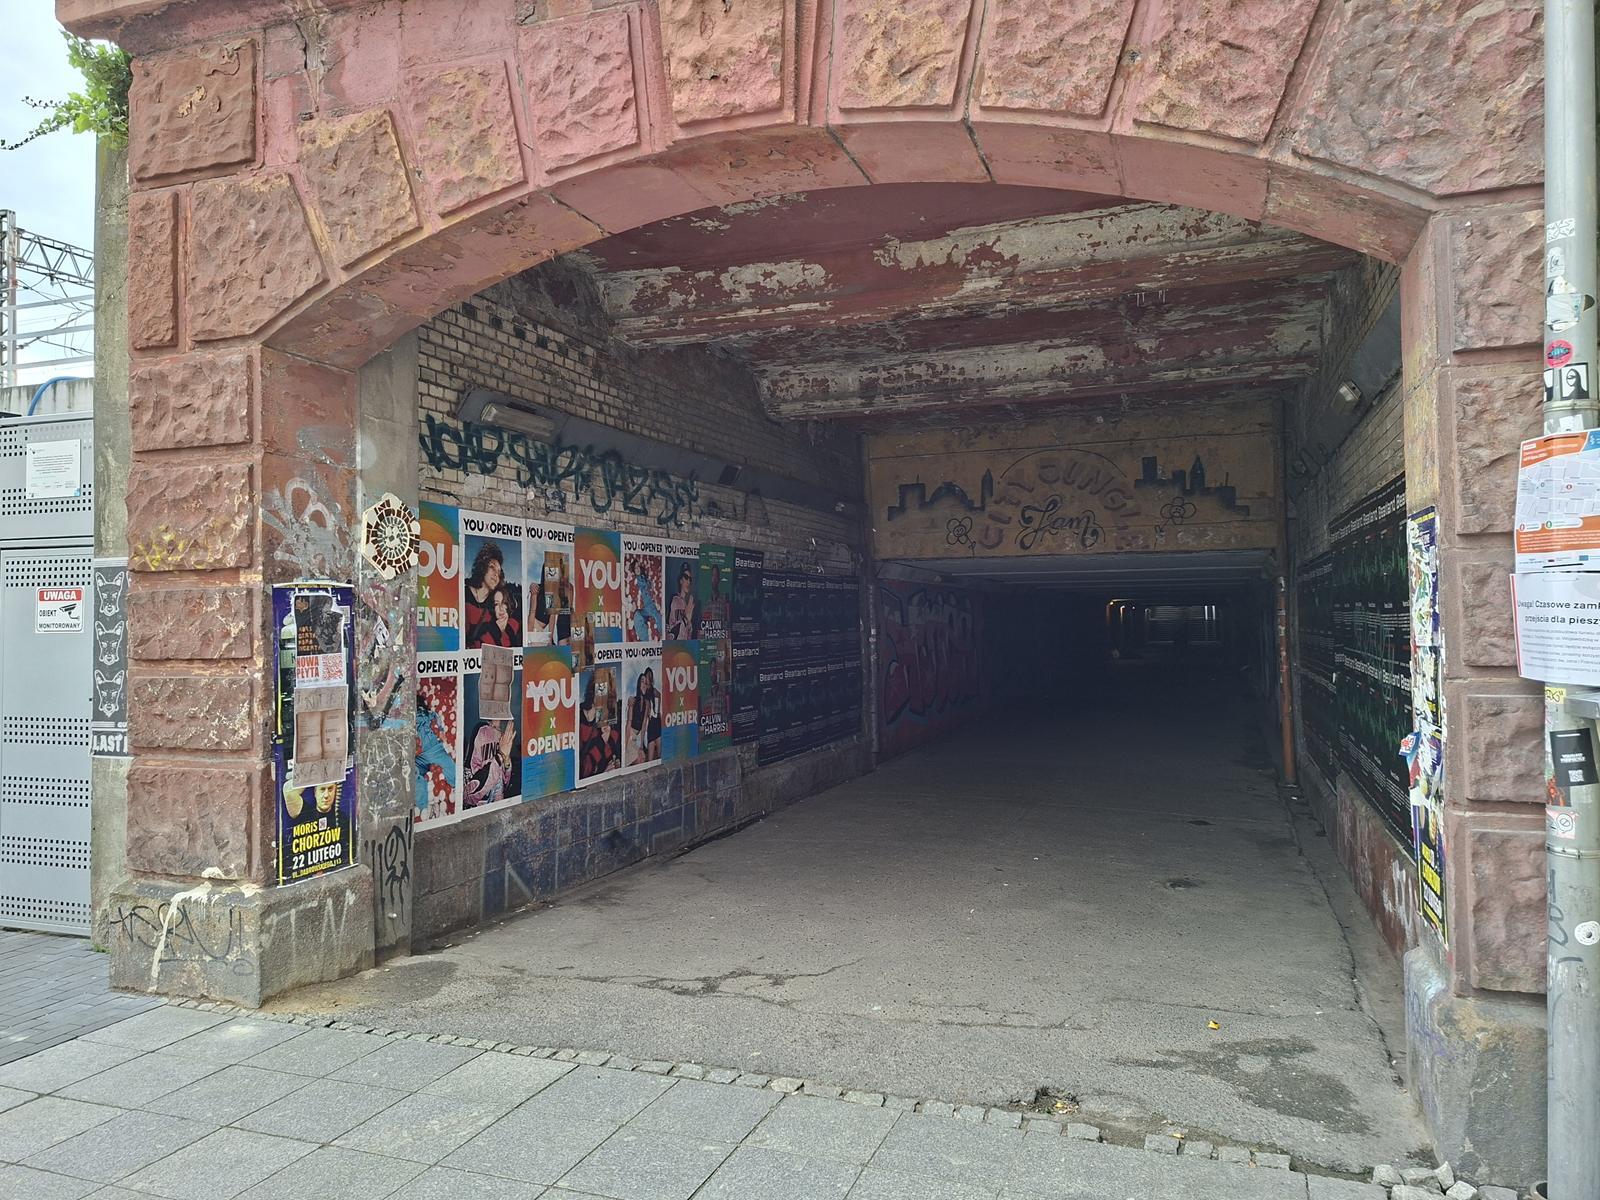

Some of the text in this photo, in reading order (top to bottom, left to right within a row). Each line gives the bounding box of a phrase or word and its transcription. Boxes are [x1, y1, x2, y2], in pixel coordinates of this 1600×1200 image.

[463, 518, 484, 533] YOU
[526, 526, 543, 540] YOU
[623, 540, 638, 551] YOU
[664, 544, 677, 555] YOU
[419, 540, 459, 579] OU
[579, 559, 621, 590] YOU
[44, 590, 77, 600] UWAGA
[1535, 600, 1570, 609] Czasowe
[39, 609, 57, 617] OBIEKT
[700, 620, 721, 630] CALVIN
[1569, 616, 1600, 625] piesz
[625, 648, 638, 658] YOU
[463, 657, 481, 671] YOU
[665, 666, 698, 692] YOU
[526, 676, 578, 712] YOU
[700, 714, 721, 726] CALVIN
[292, 827, 341, 853] CHORZÓW
[292, 843, 341, 870] 22 LUTEGO
